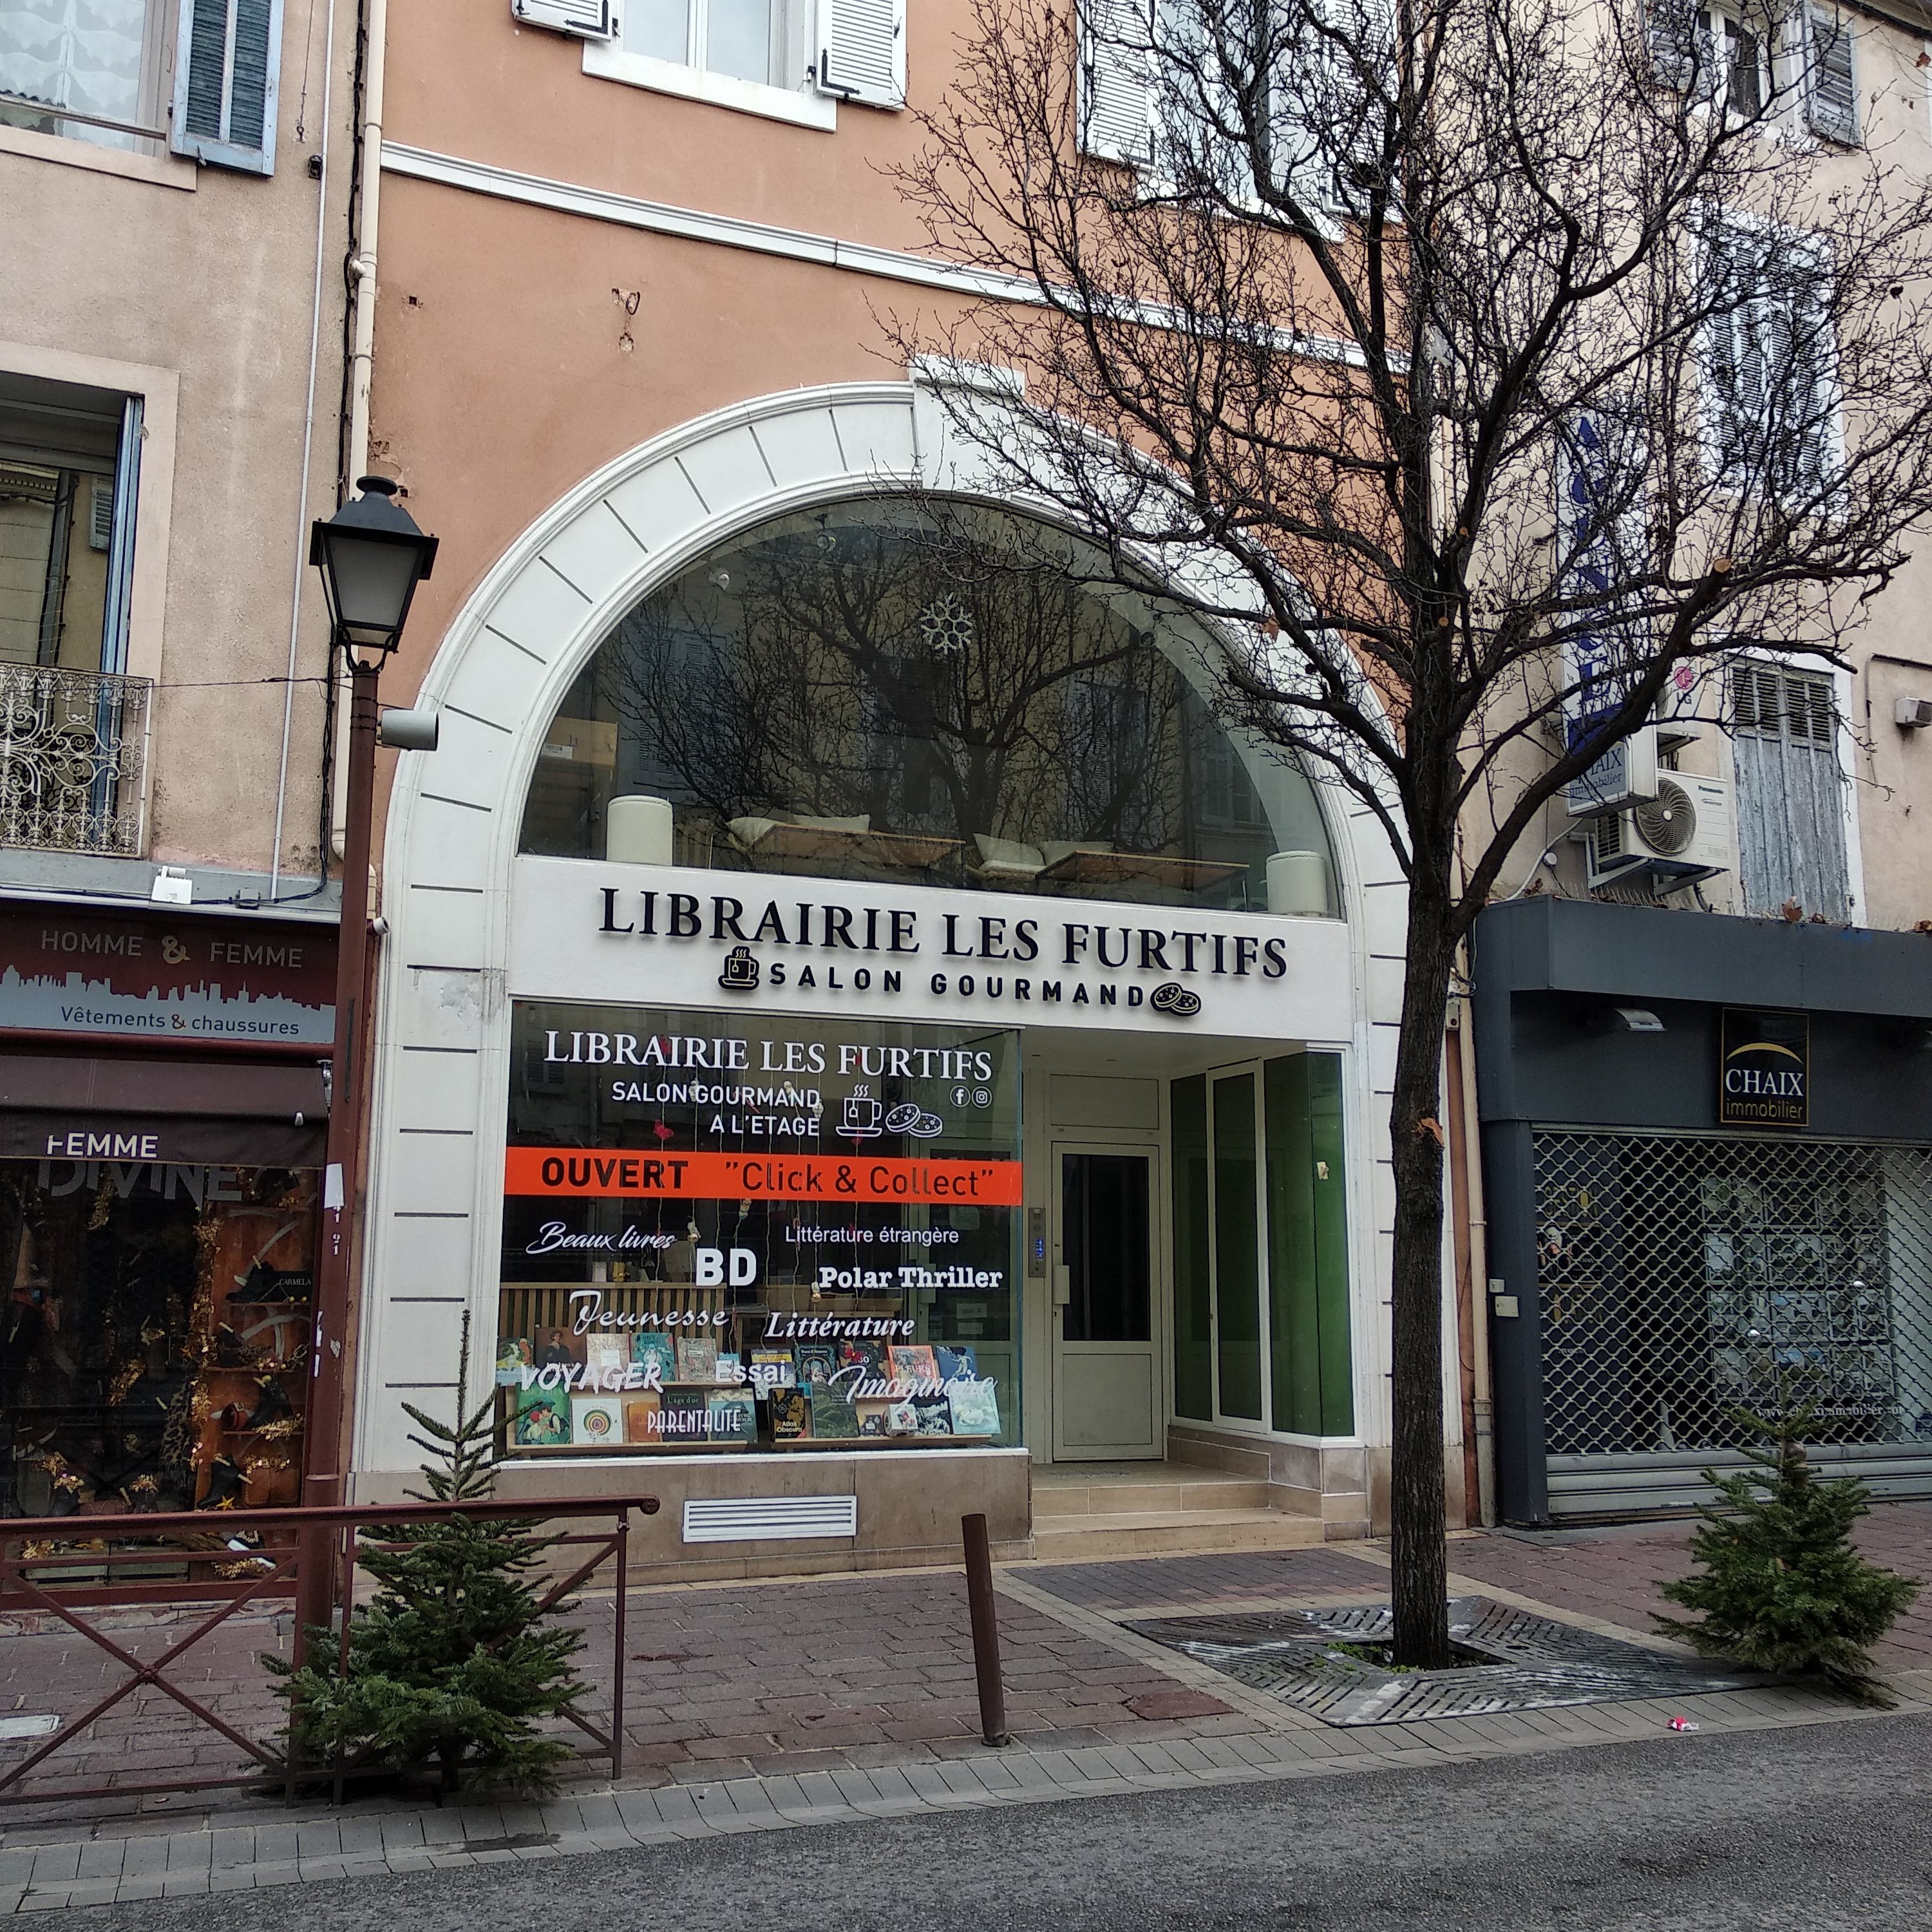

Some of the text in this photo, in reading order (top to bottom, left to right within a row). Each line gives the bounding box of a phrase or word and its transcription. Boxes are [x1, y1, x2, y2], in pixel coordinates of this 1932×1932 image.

[598, 887, 1288, 978] LIBRAIRIE LES FURTIFS
[41, 930, 303, 968] HOMME & FEMME
[770, 961, 1143, 1007] SALON GOURMAND
[61, 1006, 299, 1035] Vêtements & chaussures
[544, 1030, 992, 1081] LIBRAIRIE LES FURTIFS
[612, 1083, 820, 1109] SALON GOURMAND
[1725, 1068, 1804, 1096] CHAIX
[1726, 1097, 1803, 1119] immobilier
[542, 1157, 688, 1190] OUVERT
[835, 1167, 857, 1193] &
[526, 1221, 677, 1255] Beaux livres
[786, 1226, 960, 1247] Littérature étrangère
[696, 1248, 757, 1287] BD
[820, 1265, 1003, 1289] Polar Thriller
[569, 1290, 729, 1336] Jeunesse
[766, 1312, 915, 1338] Littérature
[520, 1362, 664, 1394] VOYAGER
[715, 1359, 785, 1383] Essai
[647, 1406, 741, 1434] PARENTALITÉ
